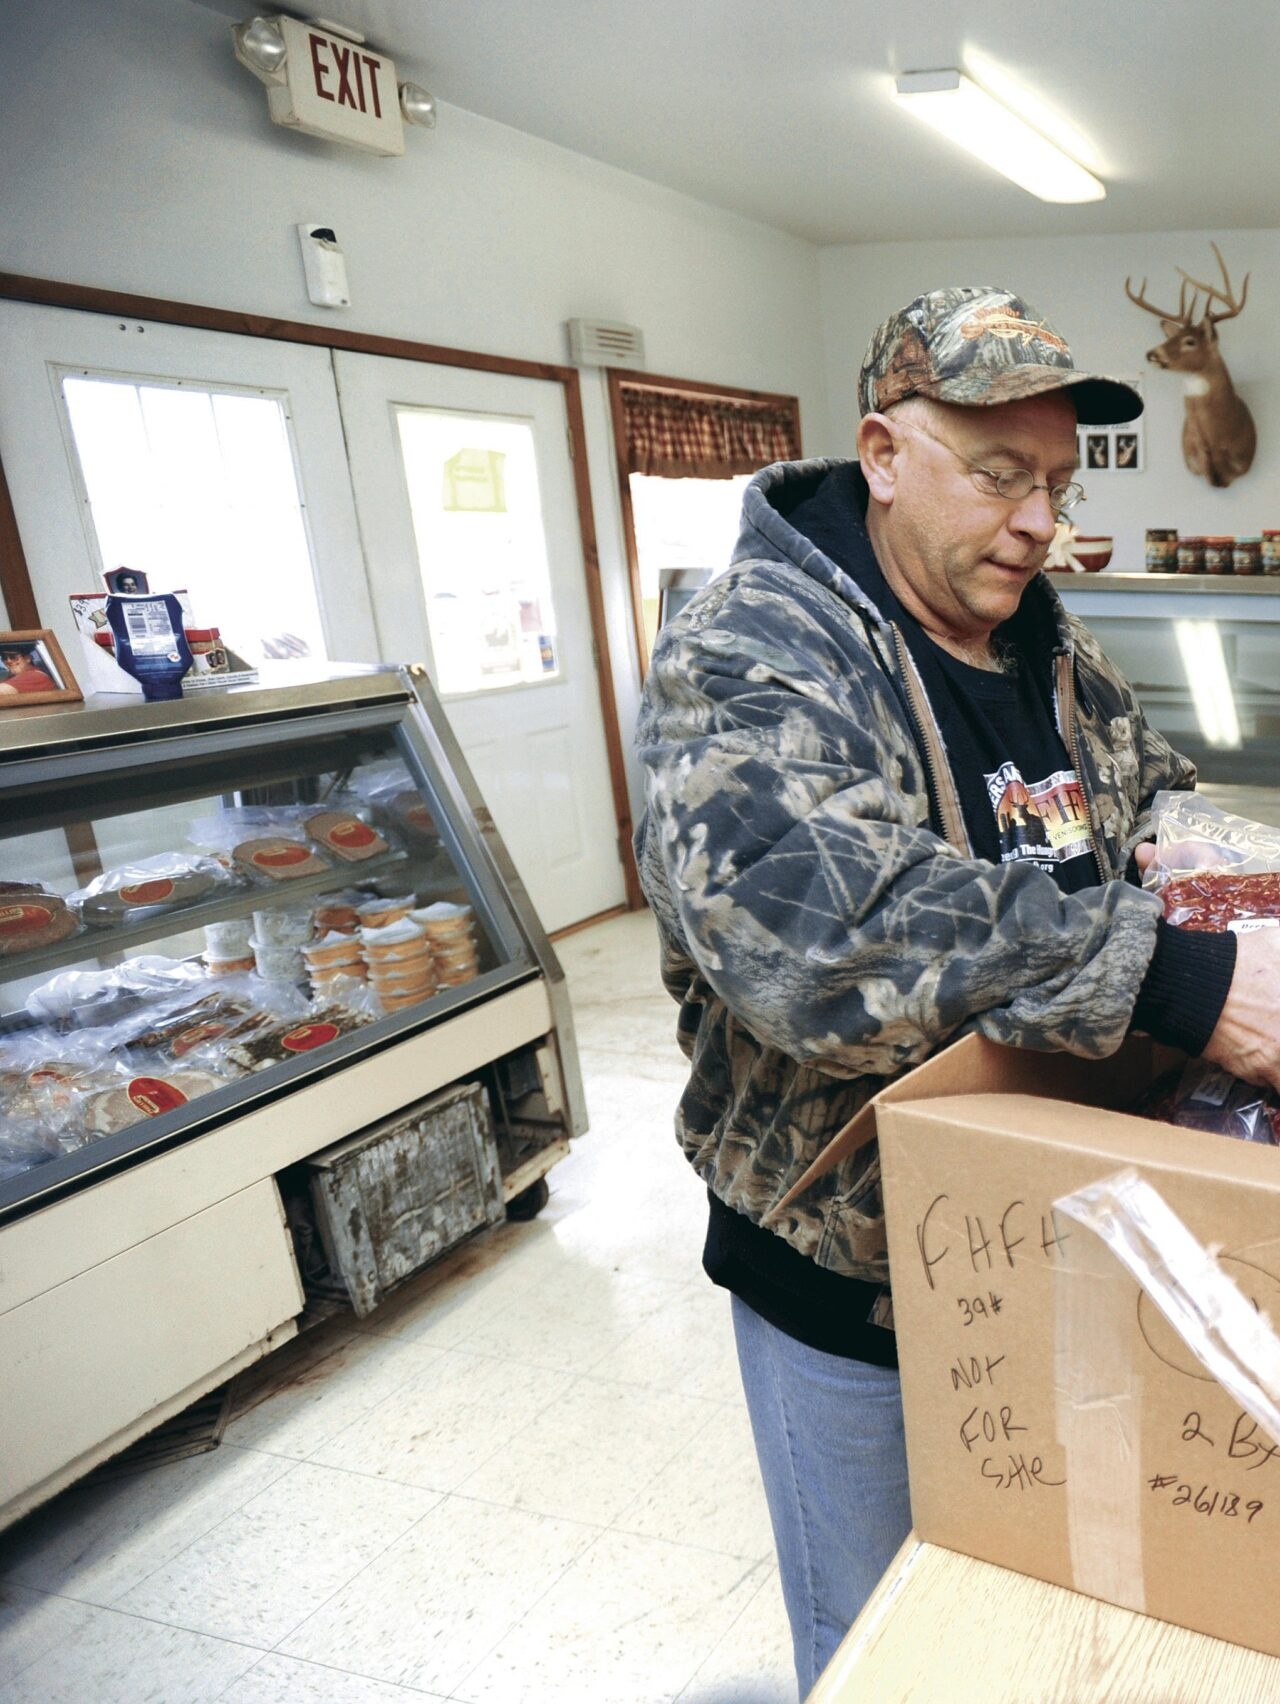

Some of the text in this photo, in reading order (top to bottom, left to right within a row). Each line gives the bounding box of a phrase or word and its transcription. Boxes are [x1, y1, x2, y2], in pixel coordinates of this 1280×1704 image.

[309, 33, 382, 119] EXIT
[916, 1193, 1073, 1292] FHFH
[959, 1406, 1029, 1453] FOR
[1181, 1411, 1215, 1447] 2
